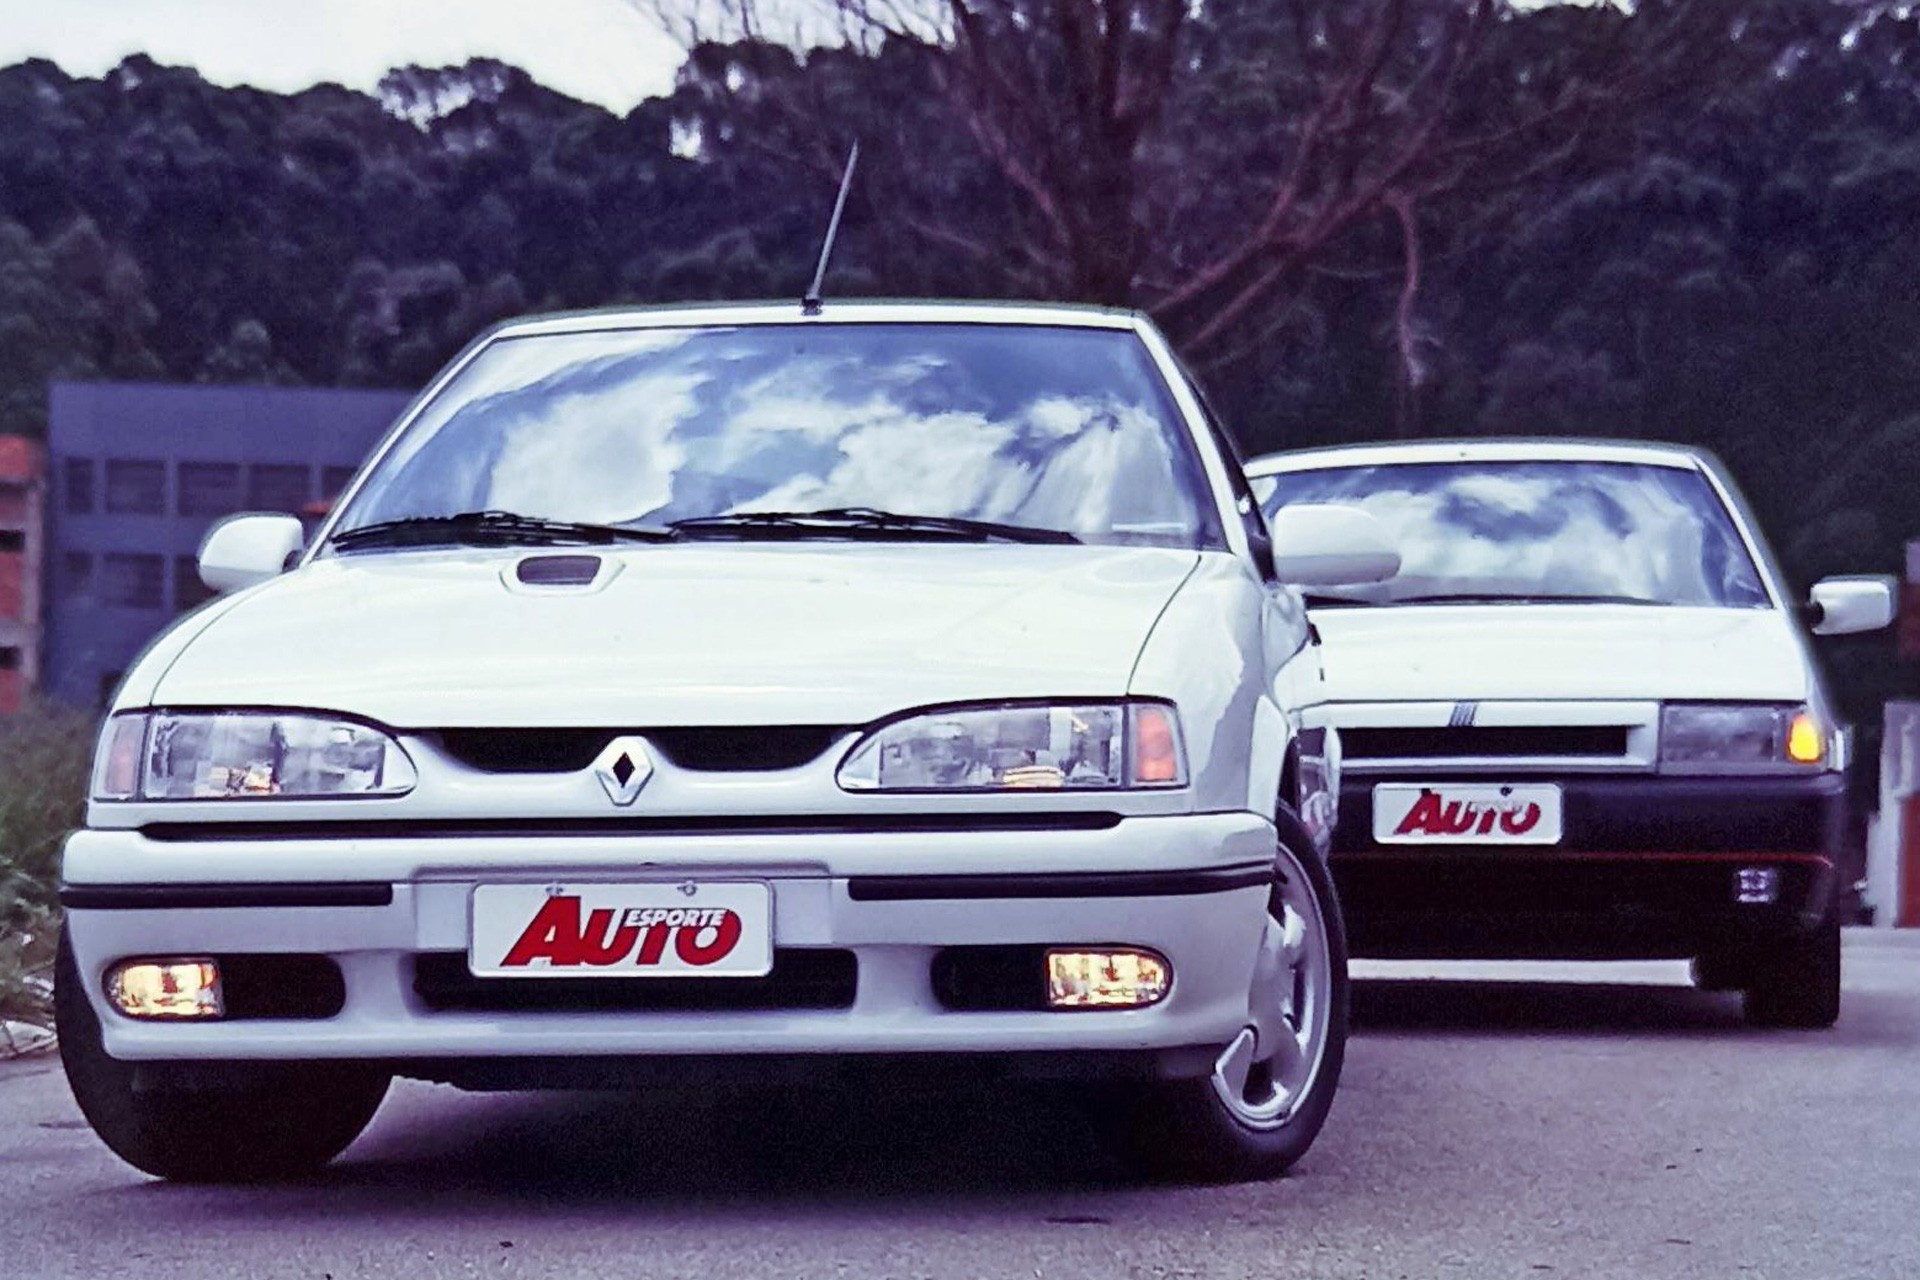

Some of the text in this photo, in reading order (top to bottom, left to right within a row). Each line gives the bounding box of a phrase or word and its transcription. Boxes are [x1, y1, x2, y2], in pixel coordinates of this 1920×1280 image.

[1393, 793, 1541, 835] AUTO
[500, 896, 742, 966] AUTO
[622, 908, 728, 928] ESPORTE
